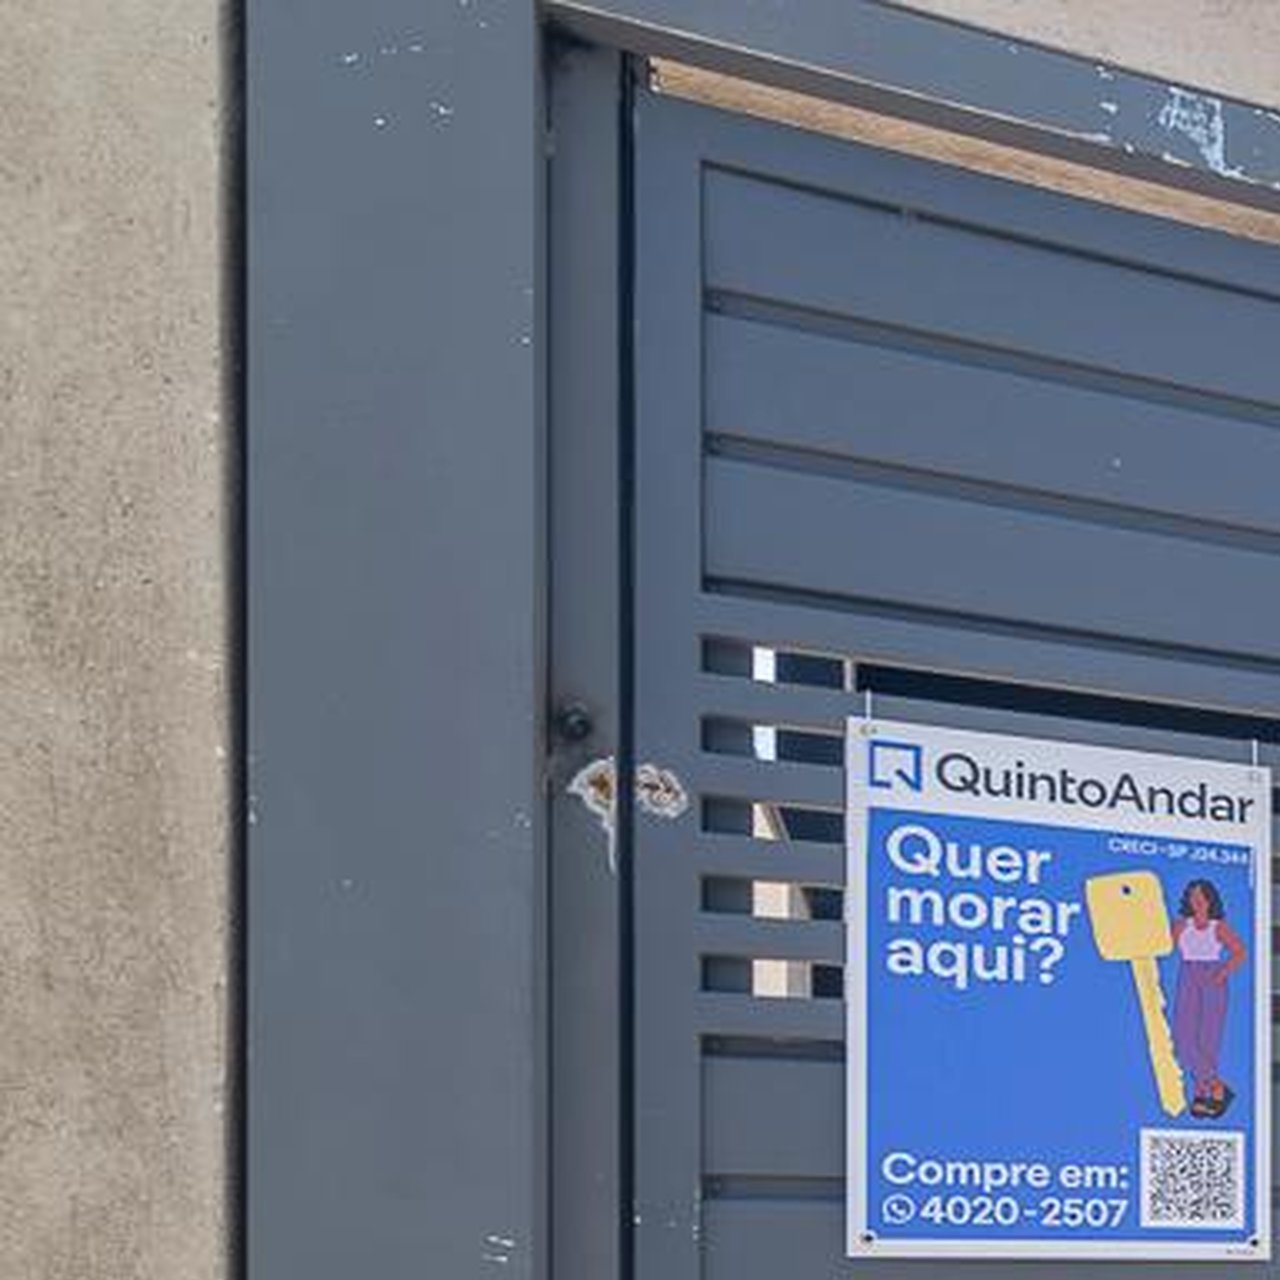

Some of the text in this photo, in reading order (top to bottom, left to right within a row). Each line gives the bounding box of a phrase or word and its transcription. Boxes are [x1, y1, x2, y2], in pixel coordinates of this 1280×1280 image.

[936, 752, 1255, 824] QuintoAndar
[886, 824, 1051, 884] Quer
[886, 886, 1081, 936] morar
[885, 936, 1065, 989] aqui?
[882, 1152, 1129, 1192] Compre em:
